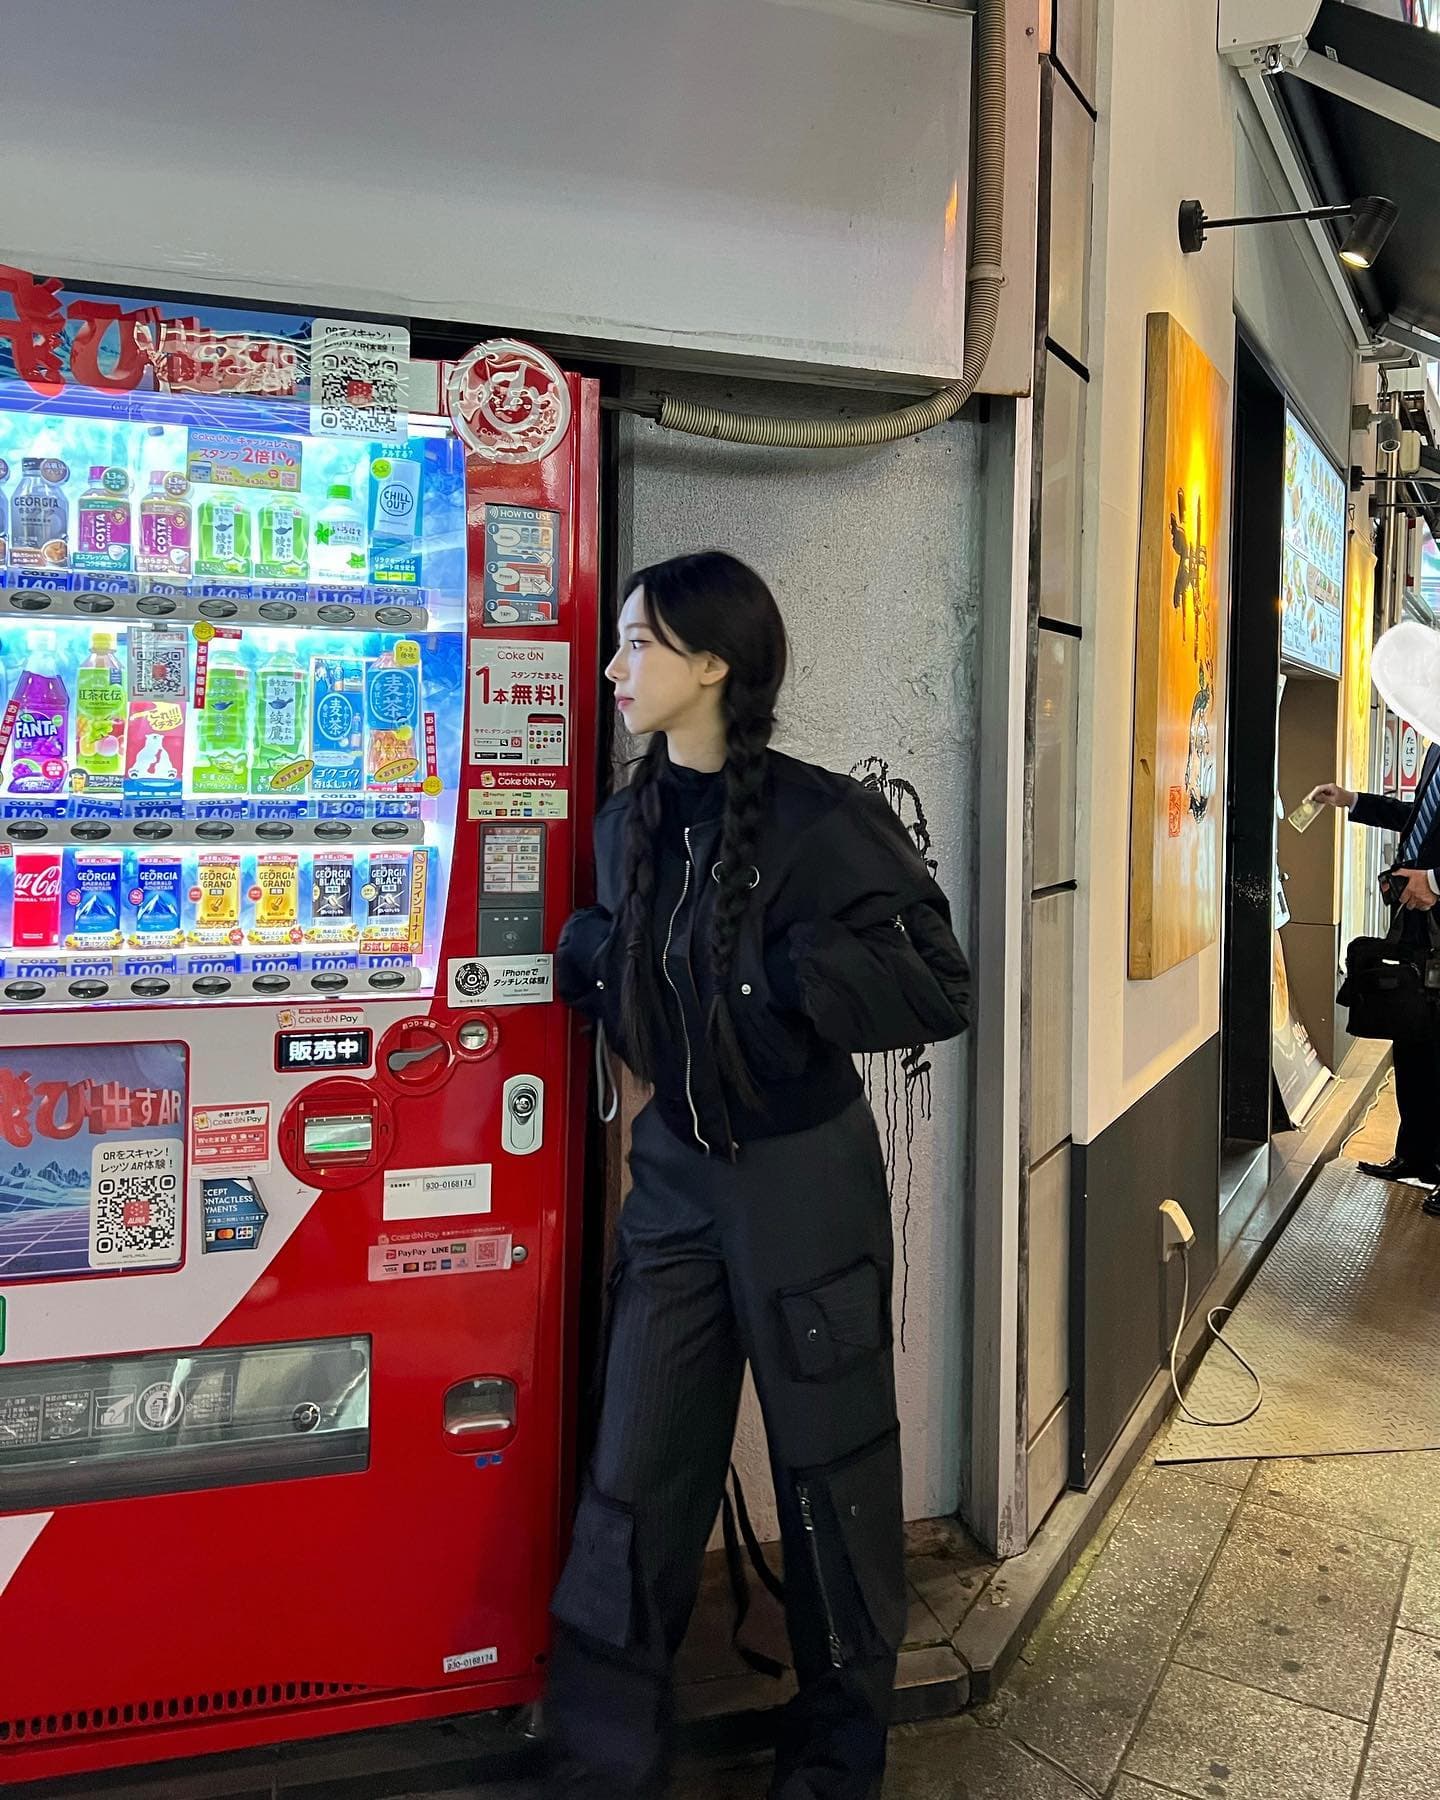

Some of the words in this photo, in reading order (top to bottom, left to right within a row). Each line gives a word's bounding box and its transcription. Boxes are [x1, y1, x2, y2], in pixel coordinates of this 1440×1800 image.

[14, 496, 59, 509] GEORGIA
[383, 490, 411, 504] CHILL
[386, 501, 406, 511] OUT
[499, 509, 521, 518] HOW
[523, 511, 534, 519] TO
[535, 512, 551, 521] USE
[95, 512, 107, 550] COSTA
[156, 517, 167, 554] COSTA
[21, 570, 59, 578] COLD
[497, 651, 525, 661] Coke
[527, 650, 544, 661] ON
[510, 671, 564, 680] スタンプたまると
[475, 665, 564, 707] 1本無料!
[382, 674, 405, 718] 麦茶
[328, 697, 343, 736] 麦茶
[15, 719, 58, 739] FANTA
[151, 717, 182, 730] イチオシ
[268, 711, 285, 742] 綾鷹
[1405, 736, 1416, 767] たばこ
[315, 768, 359, 778] ゴクゴク
[383, 764, 410, 778] おすすめ
[497, 777, 522, 786] Coke
[523, 776, 538, 786] ON
[538, 778, 556, 788] Pay
[322, 801, 364, 815] 130円
[379, 802, 420, 815] 130円
[77, 871, 116, 881] GEORGIA
[139, 871, 178, 881] GEORGIA
[200, 871, 237, 881] GEORGIA
[259, 871, 296, 880] GEORGIA
[315, 869, 351, 879] GEORGIA
[371, 868, 407, 878] GEORGIA
[203, 880, 232, 888] GRAND
[263, 880, 292, 888] GRAND
[319, 877, 346, 886] BLACK
[375, 876, 402, 885] BLACK
[413, 864, 424, 941] ワンコインコーナー
[362, 941, 409, 952] お試し価格
[502, 968, 539, 977] iPhoneで
[493, 976, 549, 988] タッチレス体験!
[298, 1015, 322, 1024] Coke
[323, 1014, 338, 1023] ON
[340, 1014, 359, 1024] Pay
[289, 1037, 359, 1062] 販売中
[246, 1116, 262, 1125] Pay
[425, 1179, 472, 1191] 930-0168174
[205, 1205, 238, 1214] YMENTS
[398, 1248, 427, 1258] PayPay
[431, 1246, 449, 1254] LINE
